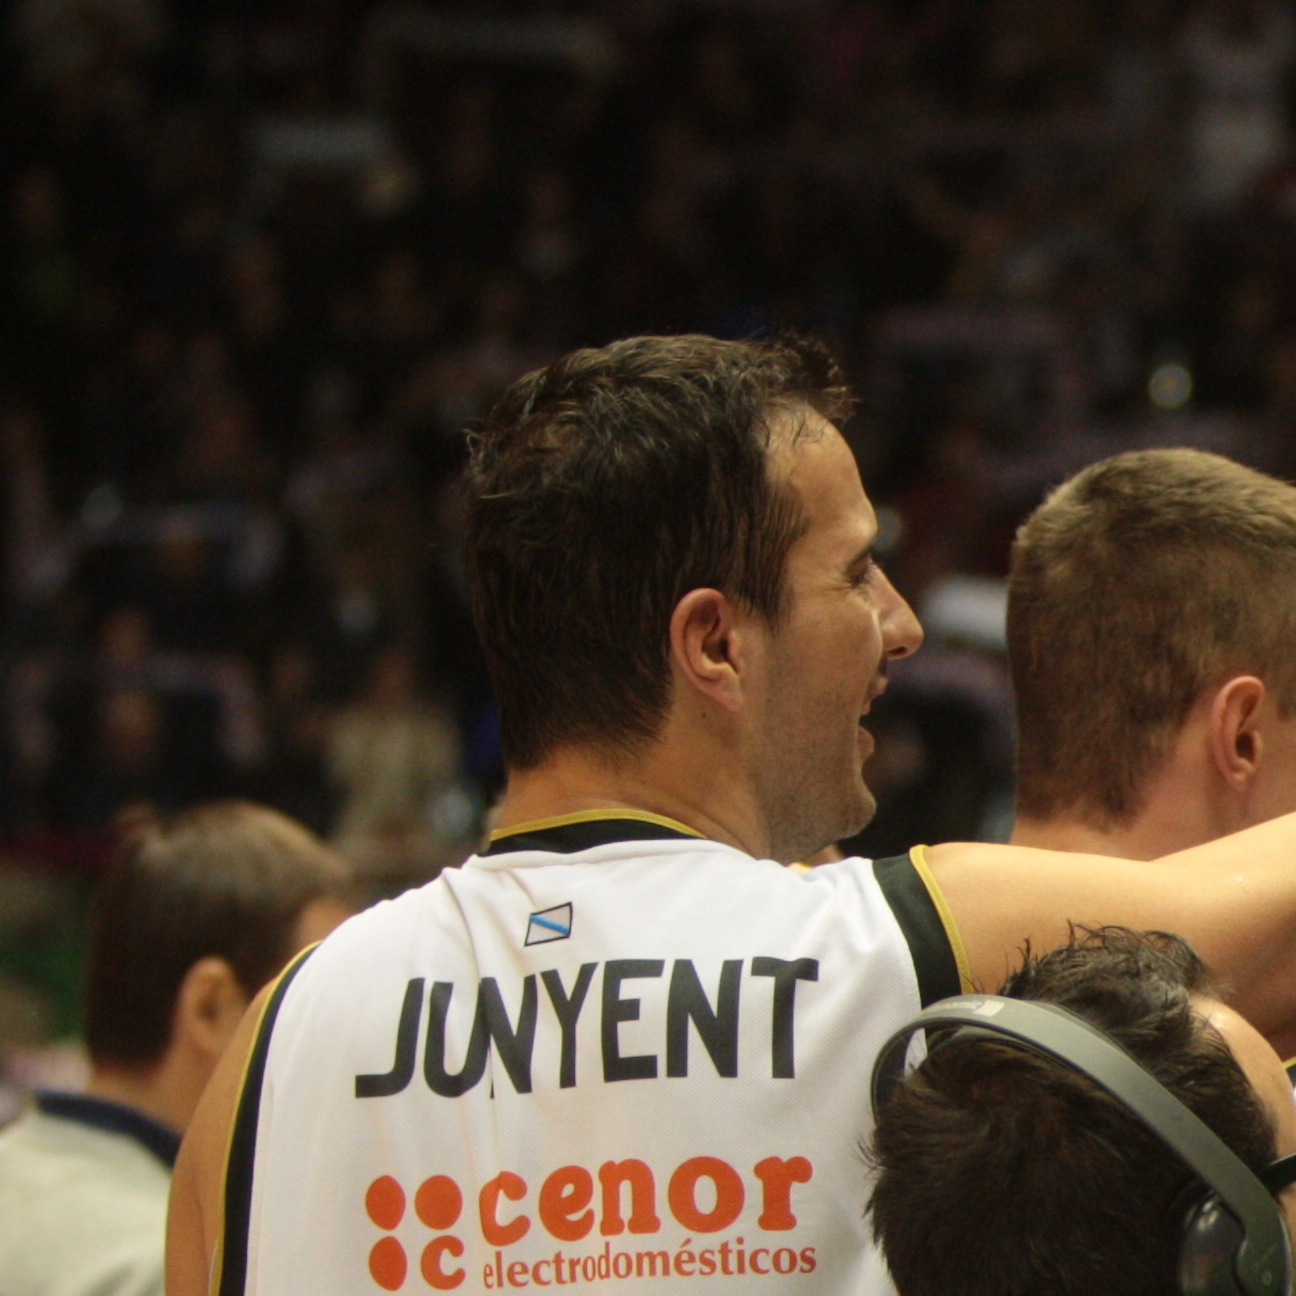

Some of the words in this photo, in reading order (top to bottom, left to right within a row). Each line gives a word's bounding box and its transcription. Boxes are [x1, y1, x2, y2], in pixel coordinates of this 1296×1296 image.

[355, 956, 819, 1099] JUNYENT
[479, 1156, 813, 1247] cenor
[482, 1237, 818, 1290] electrodomésticos
